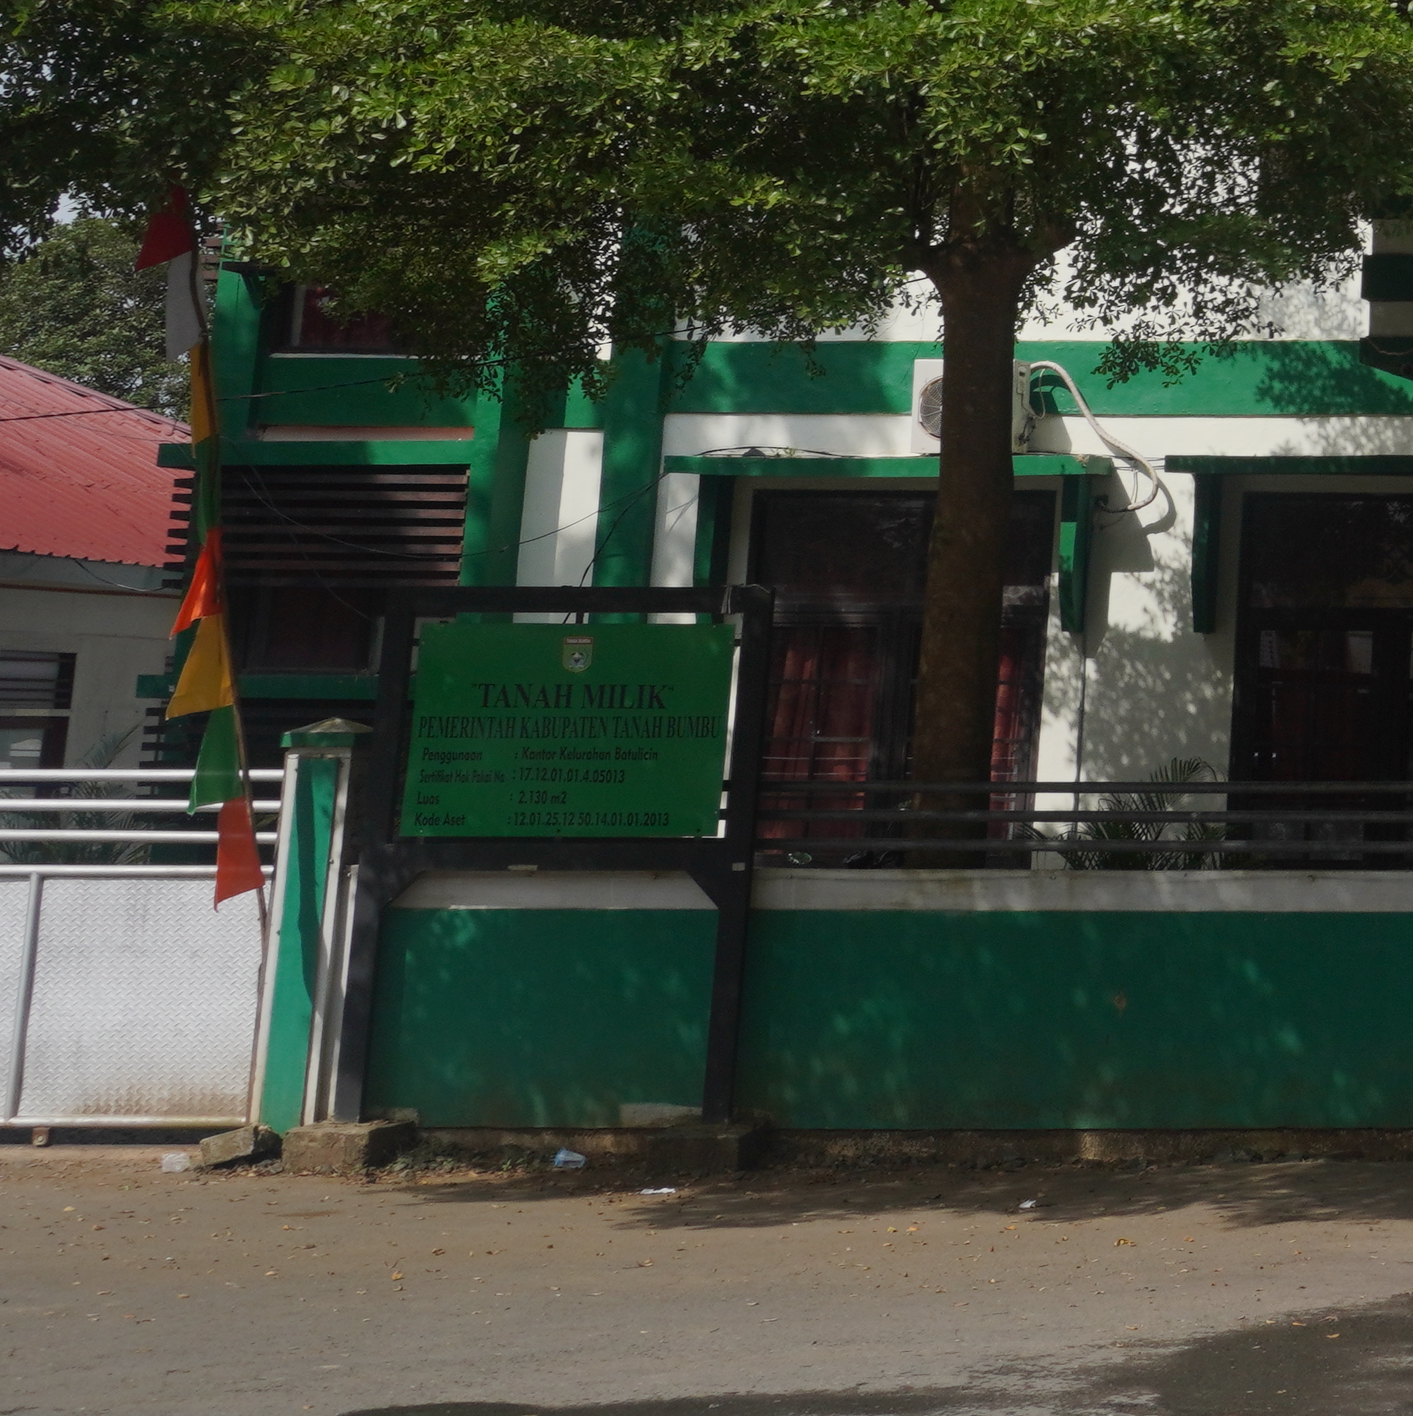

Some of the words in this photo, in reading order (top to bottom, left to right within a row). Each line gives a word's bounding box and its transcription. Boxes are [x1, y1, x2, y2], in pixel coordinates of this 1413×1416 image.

[418, 716, 515, 738] PEMERINTAH
[519, 716, 608, 740] KABUPATEN
[612, 717, 662, 738] TANAH
[667, 716, 722, 739] BUMBU
[422, 748, 482, 764] Penggunaan
[522, 748, 557, 761] Kantor
[559, 748, 611, 761] Kelurahan
[614, 747, 658, 761] Batulicin
[417, 791, 440, 805] Luas
[518, 790, 548, 804] 2.130
[550, 791, 567, 804] m2
[415, 813, 441, 826] Kode
[442, 813, 466, 827] Aset
